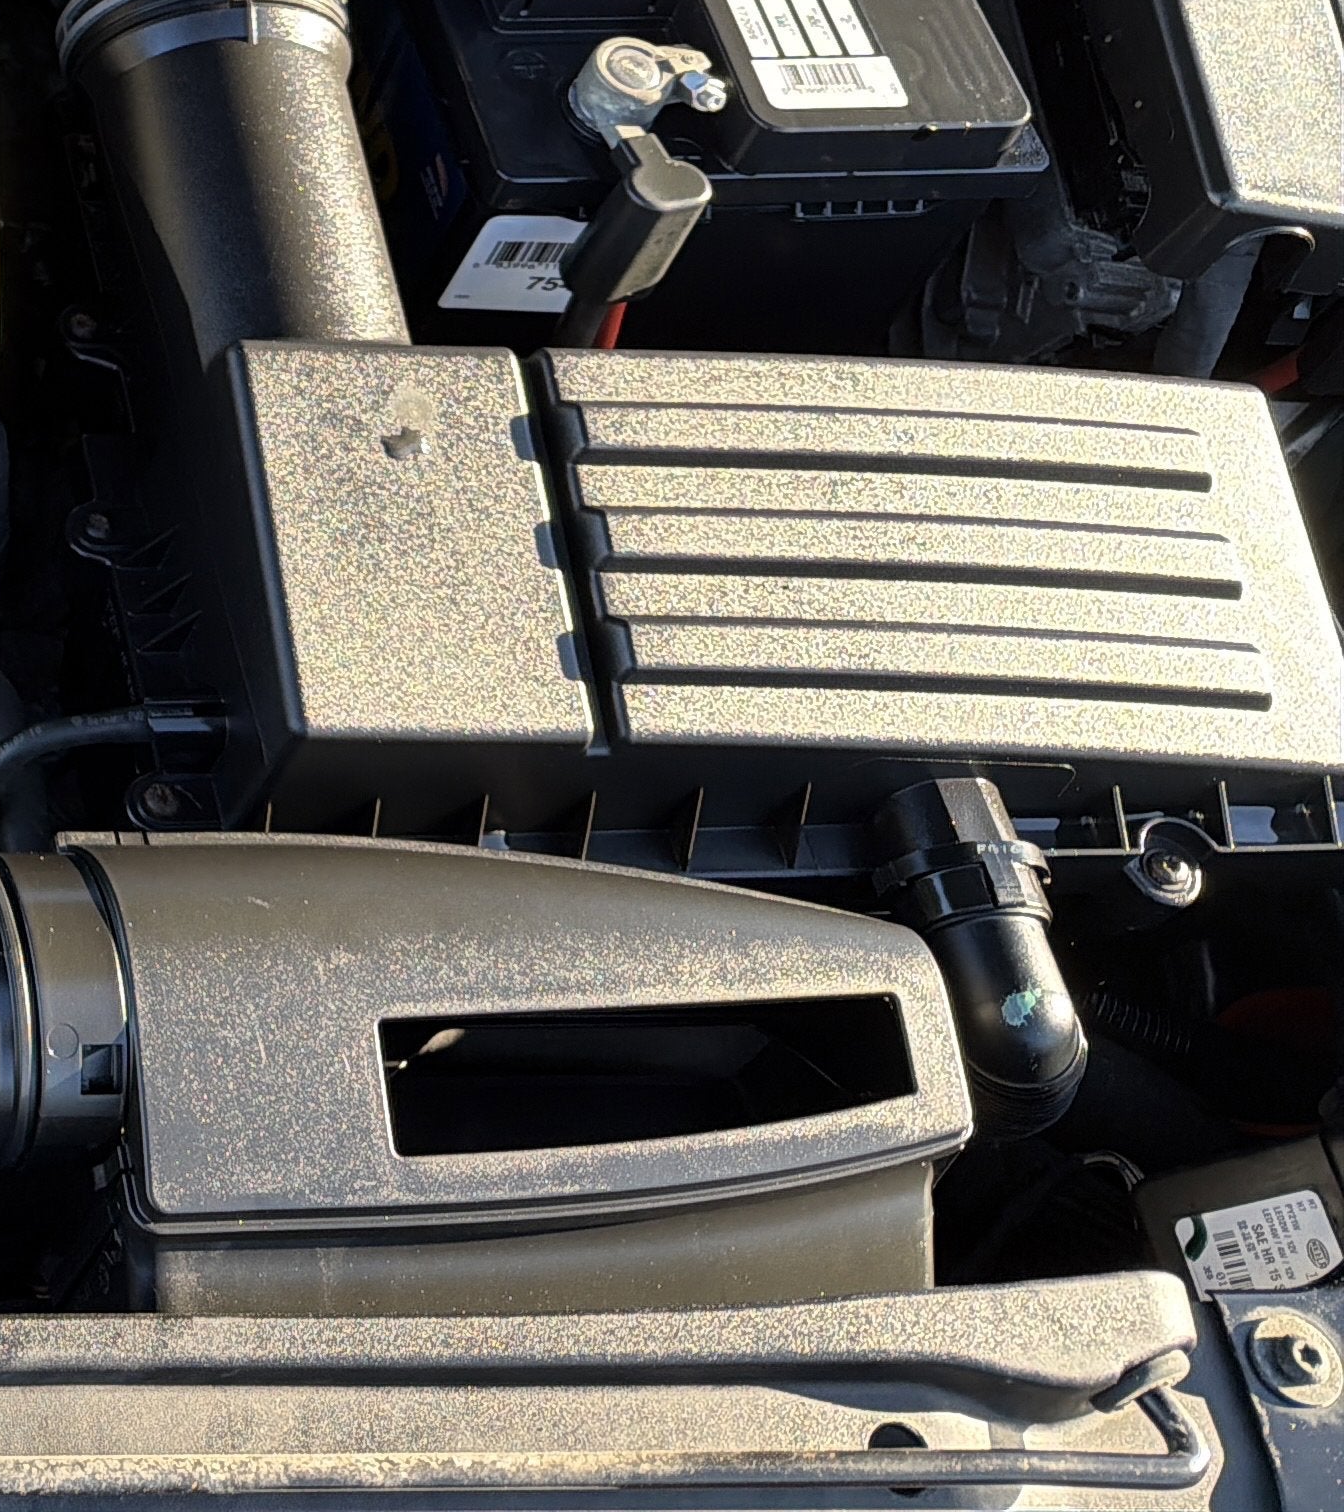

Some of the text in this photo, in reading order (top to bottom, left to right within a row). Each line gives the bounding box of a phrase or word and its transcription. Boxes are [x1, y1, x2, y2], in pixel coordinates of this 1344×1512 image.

[1251, 1223, 1269, 1247] SAE
[1261, 1247, 1276, 1266] HR
[1269, 1268, 1282, 1282] 15
